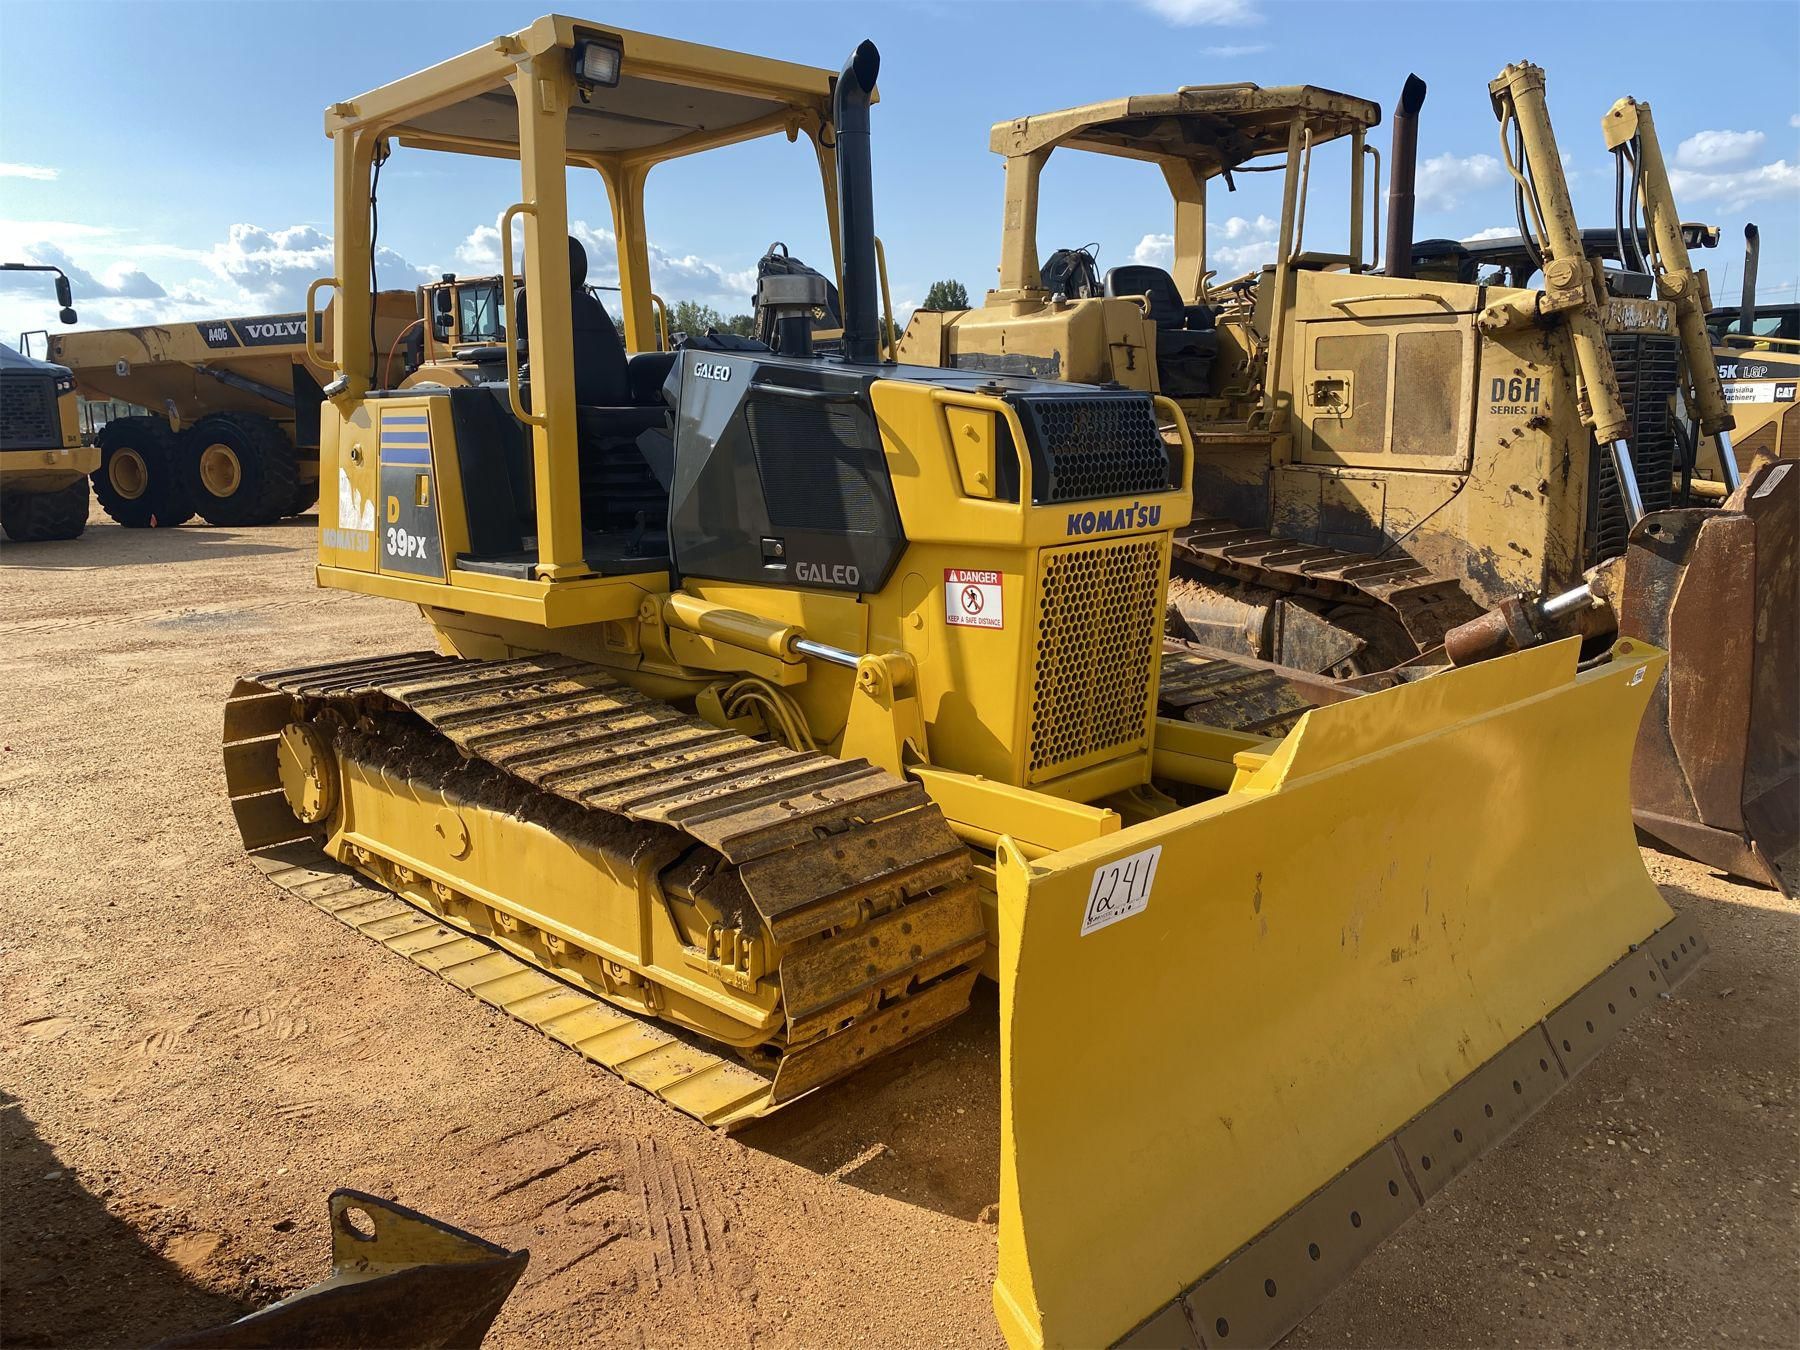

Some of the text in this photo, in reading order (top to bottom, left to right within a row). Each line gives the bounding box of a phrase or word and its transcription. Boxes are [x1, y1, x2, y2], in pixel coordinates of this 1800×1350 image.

[208, 327, 228, 342] A40G
[694, 362, 731, 382] GALEO
[1717, 364, 1768, 379] 5K LGP
[1491, 377, 1540, 402] D6H
[1724, 386, 1754, 394] ouisiana
[1776, 387, 1794, 398] CAT
[1490, 405, 1538, 415] SERIES II
[387, 495, 400, 524] D
[1067, 502, 1161, 535] KOMATSU
[323, 528, 369, 552] KOMATSU
[387, 527, 427, 559] 39PX
[795, 561, 860, 586] GALEO
[960, 571, 997, 583] DANGER
[978, 617, 1000, 626] DISTANCE
[1088, 854, 1154, 919] 1241
